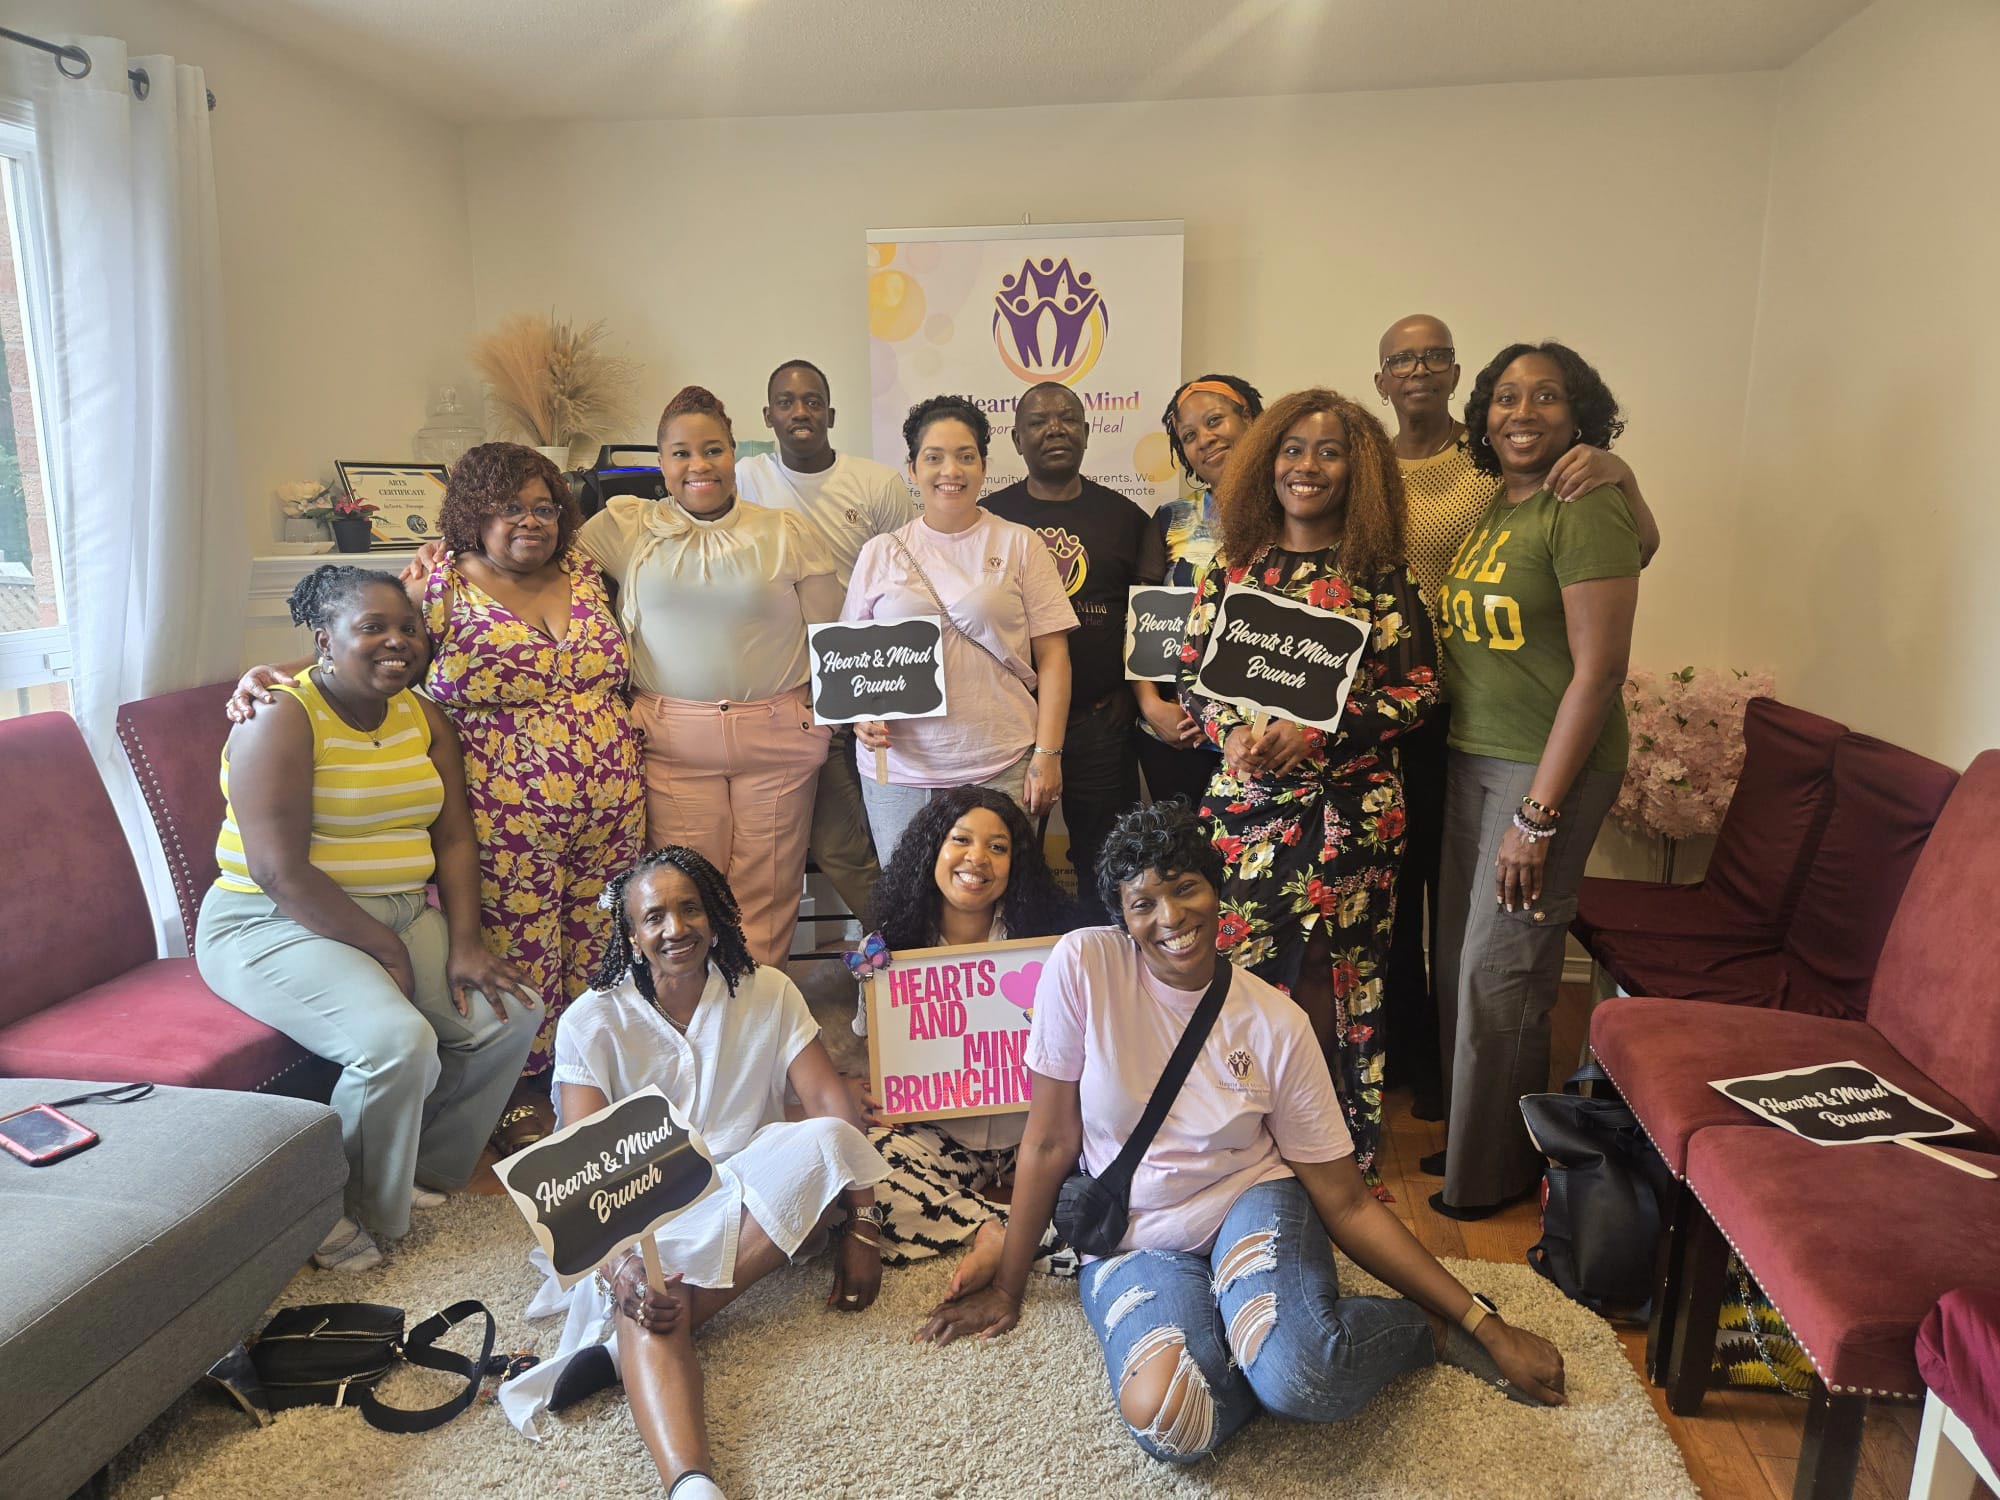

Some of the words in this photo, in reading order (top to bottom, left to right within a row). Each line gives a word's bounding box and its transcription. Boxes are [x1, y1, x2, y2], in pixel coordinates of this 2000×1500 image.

[1084, 391, 1140, 411] Mind
[1091, 415, 1124, 433] Heal
[1139, 612, 1184, 632] Hearts
[1225, 618, 1281, 652] Hearts
[1279, 635, 1294, 657] &
[1294, 638, 1349, 669] Mind
[822, 650, 872, 673] Hearts
[872, 648, 885, 668] &
[886, 646, 932, 668] Mind
[1246, 655, 1306, 689] Brunch
[850, 674, 907, 698] Brunch
[887, 959, 996, 1008] HEARTS
[909, 1000, 968, 1041] AND
[1759, 1097, 1824, 1114] Hearts
[1815, 1091, 1842, 1106] &
[1830, 1083, 1888, 1105] Mind
[1818, 1107, 1892, 1128] Brunch
[535, 1159, 602, 1213] Hearts
[599, 1151, 622, 1173] &
[616, 1117, 673, 1164] Mind
[589, 1163, 662, 1224] Brunch
